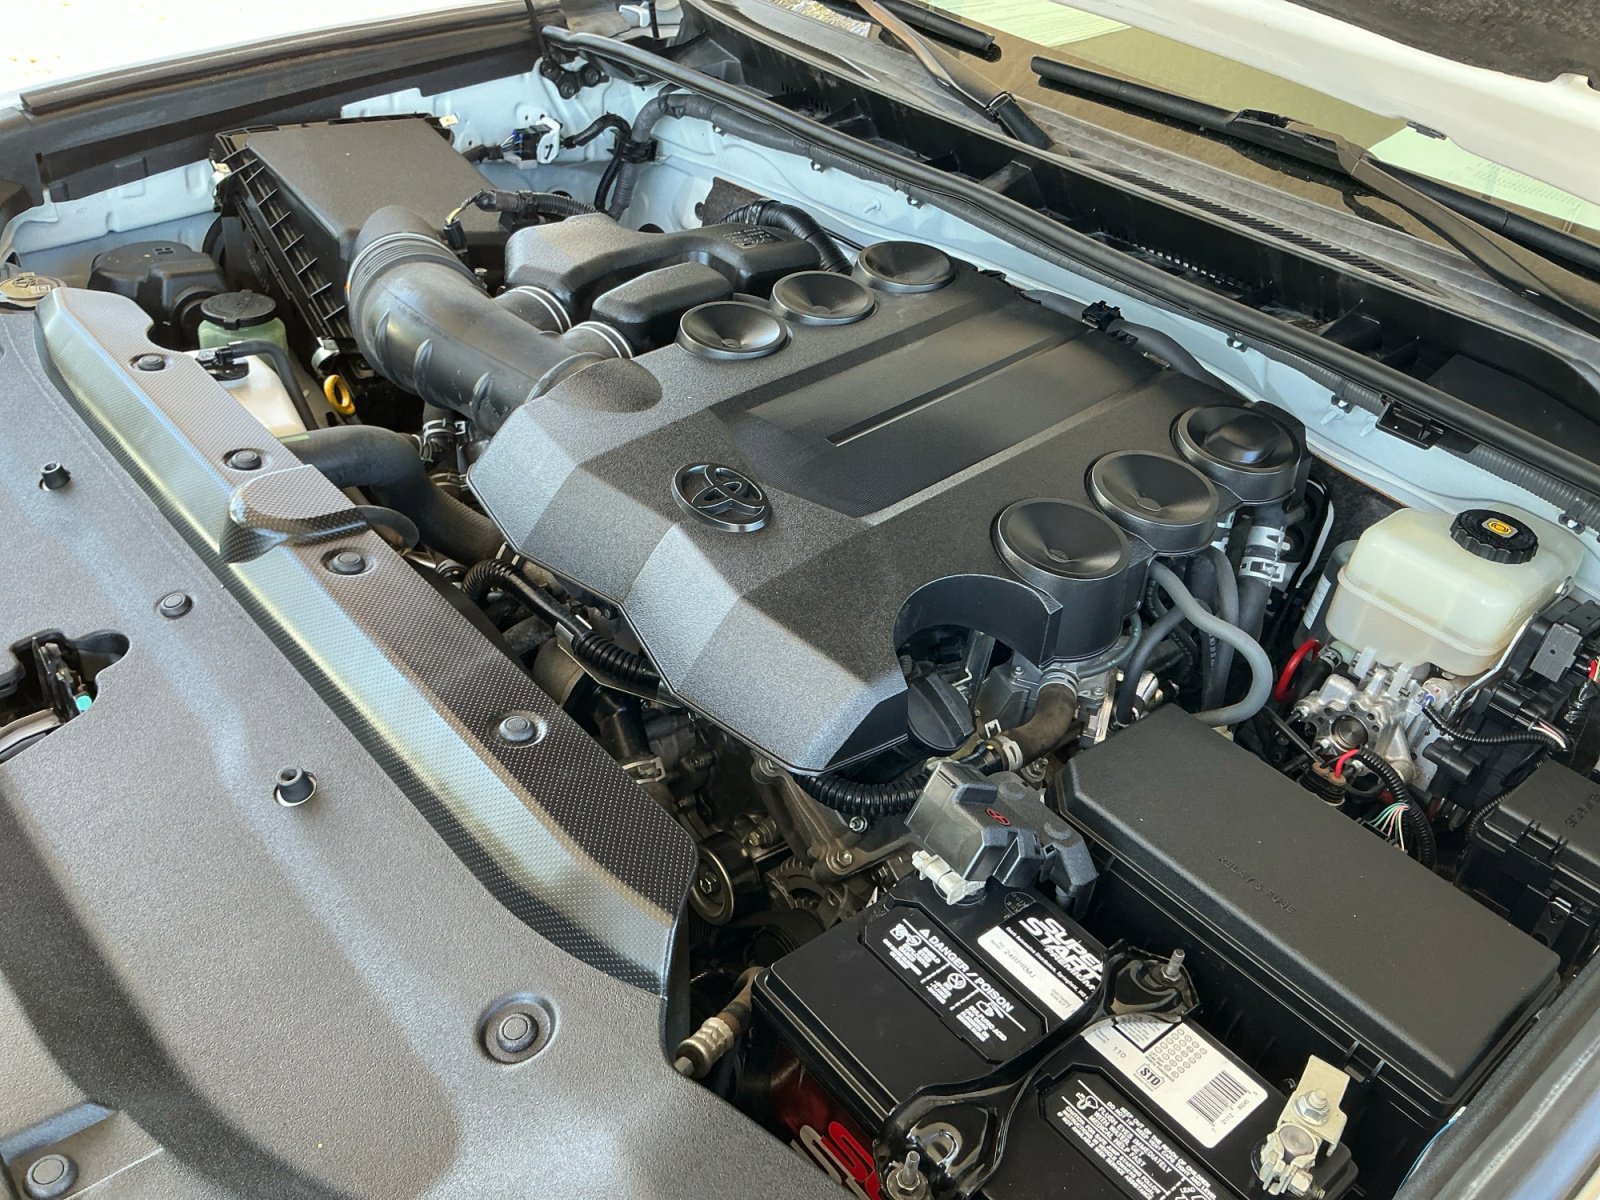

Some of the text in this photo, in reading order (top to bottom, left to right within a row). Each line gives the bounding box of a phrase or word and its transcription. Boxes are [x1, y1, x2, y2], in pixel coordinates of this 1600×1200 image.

[1217, 855, 1256, 883] RELAY
[927, 935, 970, 972] DANGER
[973, 976, 1014, 1012] POISON
[1018, 916, 1102, 985] START
[1044, 946, 1096, 991] PREMIUM
[1139, 1066, 1161, 1086] STD
[1106, 1101, 1116, 1109] DO
[1113, 1108, 1126, 1118] NOT
[1132, 1117, 1144, 1128] OUT
[1087, 1115, 1146, 1167] MEDICAL HELP FAST
[1092, 1110, 1110, 1126] WITH
[1129, 1144, 1144, 1157] GET
[1097, 1106, 1172, 1173] FLUSH EYES IMMEDIATELY
